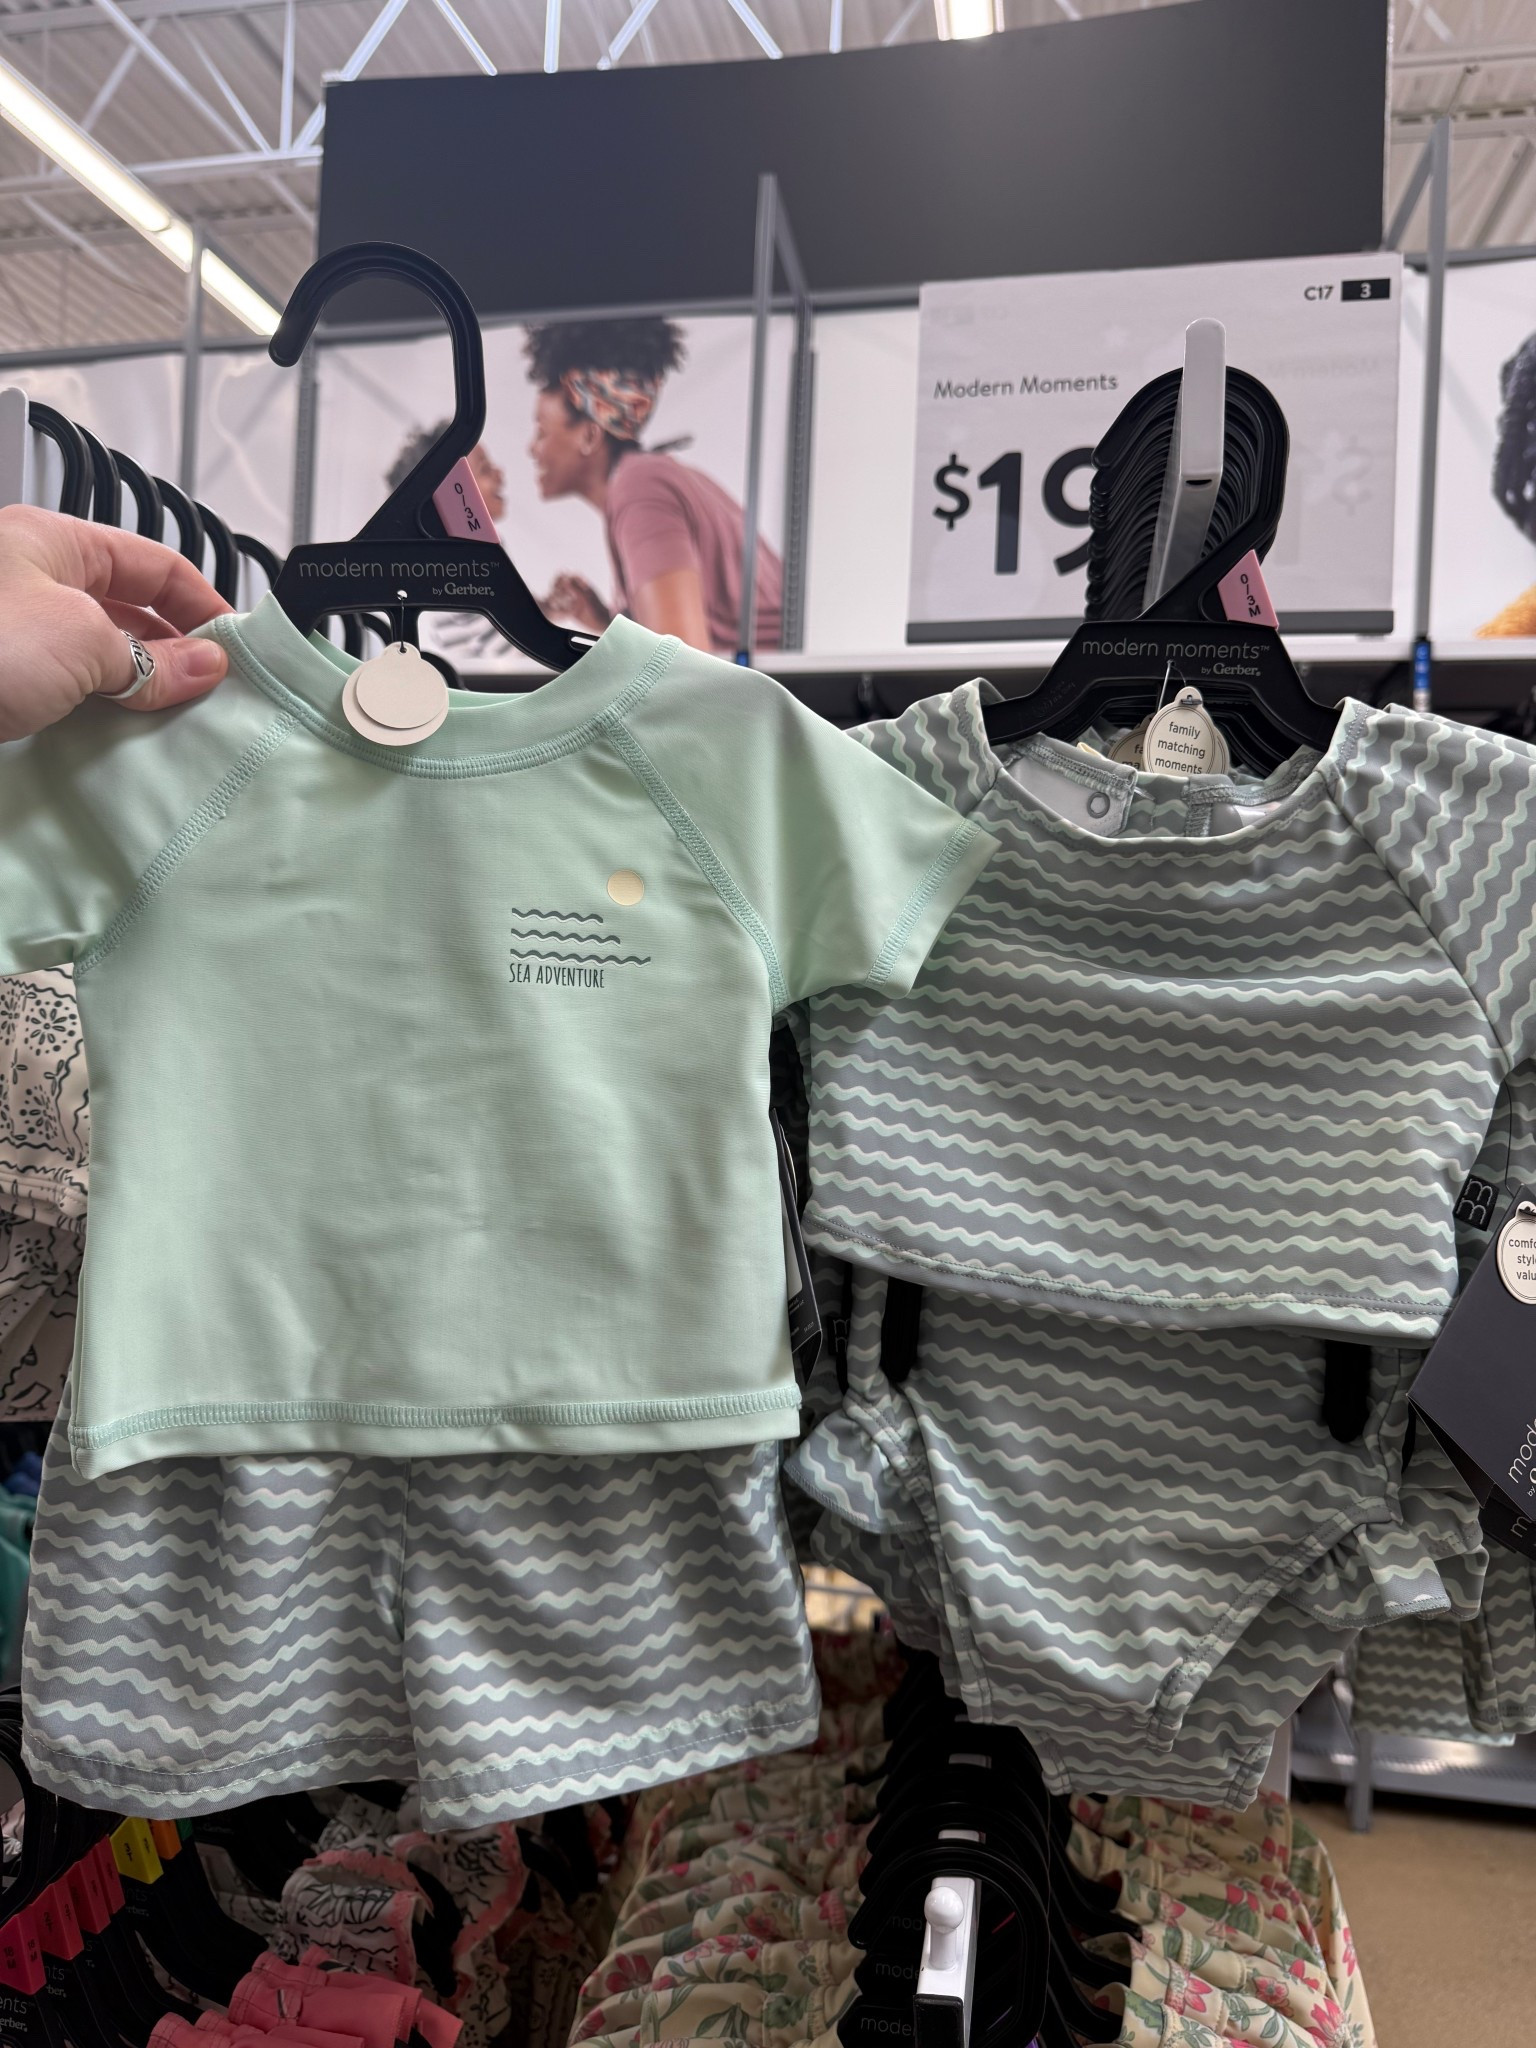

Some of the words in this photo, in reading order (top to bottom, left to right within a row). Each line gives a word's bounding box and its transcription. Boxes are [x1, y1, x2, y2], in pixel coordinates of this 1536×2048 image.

[1304, 285, 1333, 301] C17
[1360, 282, 1371, 298] 3
[934, 378, 1014, 399] Modern
[1019, 373, 1119, 395] Moments
[299, 557, 384, 577] modern
[432, 587, 443, 596] by
[1082, 637, 1159, 657] modern
[1201, 666, 1212, 676] by
[1168, 721, 1201, 740] family
[1157, 739, 1206, 760] matching
[1154, 757, 1203, 775] moments
[509, 963, 531, 983] SEA
[536, 966, 605, 988] ADVENTURE
